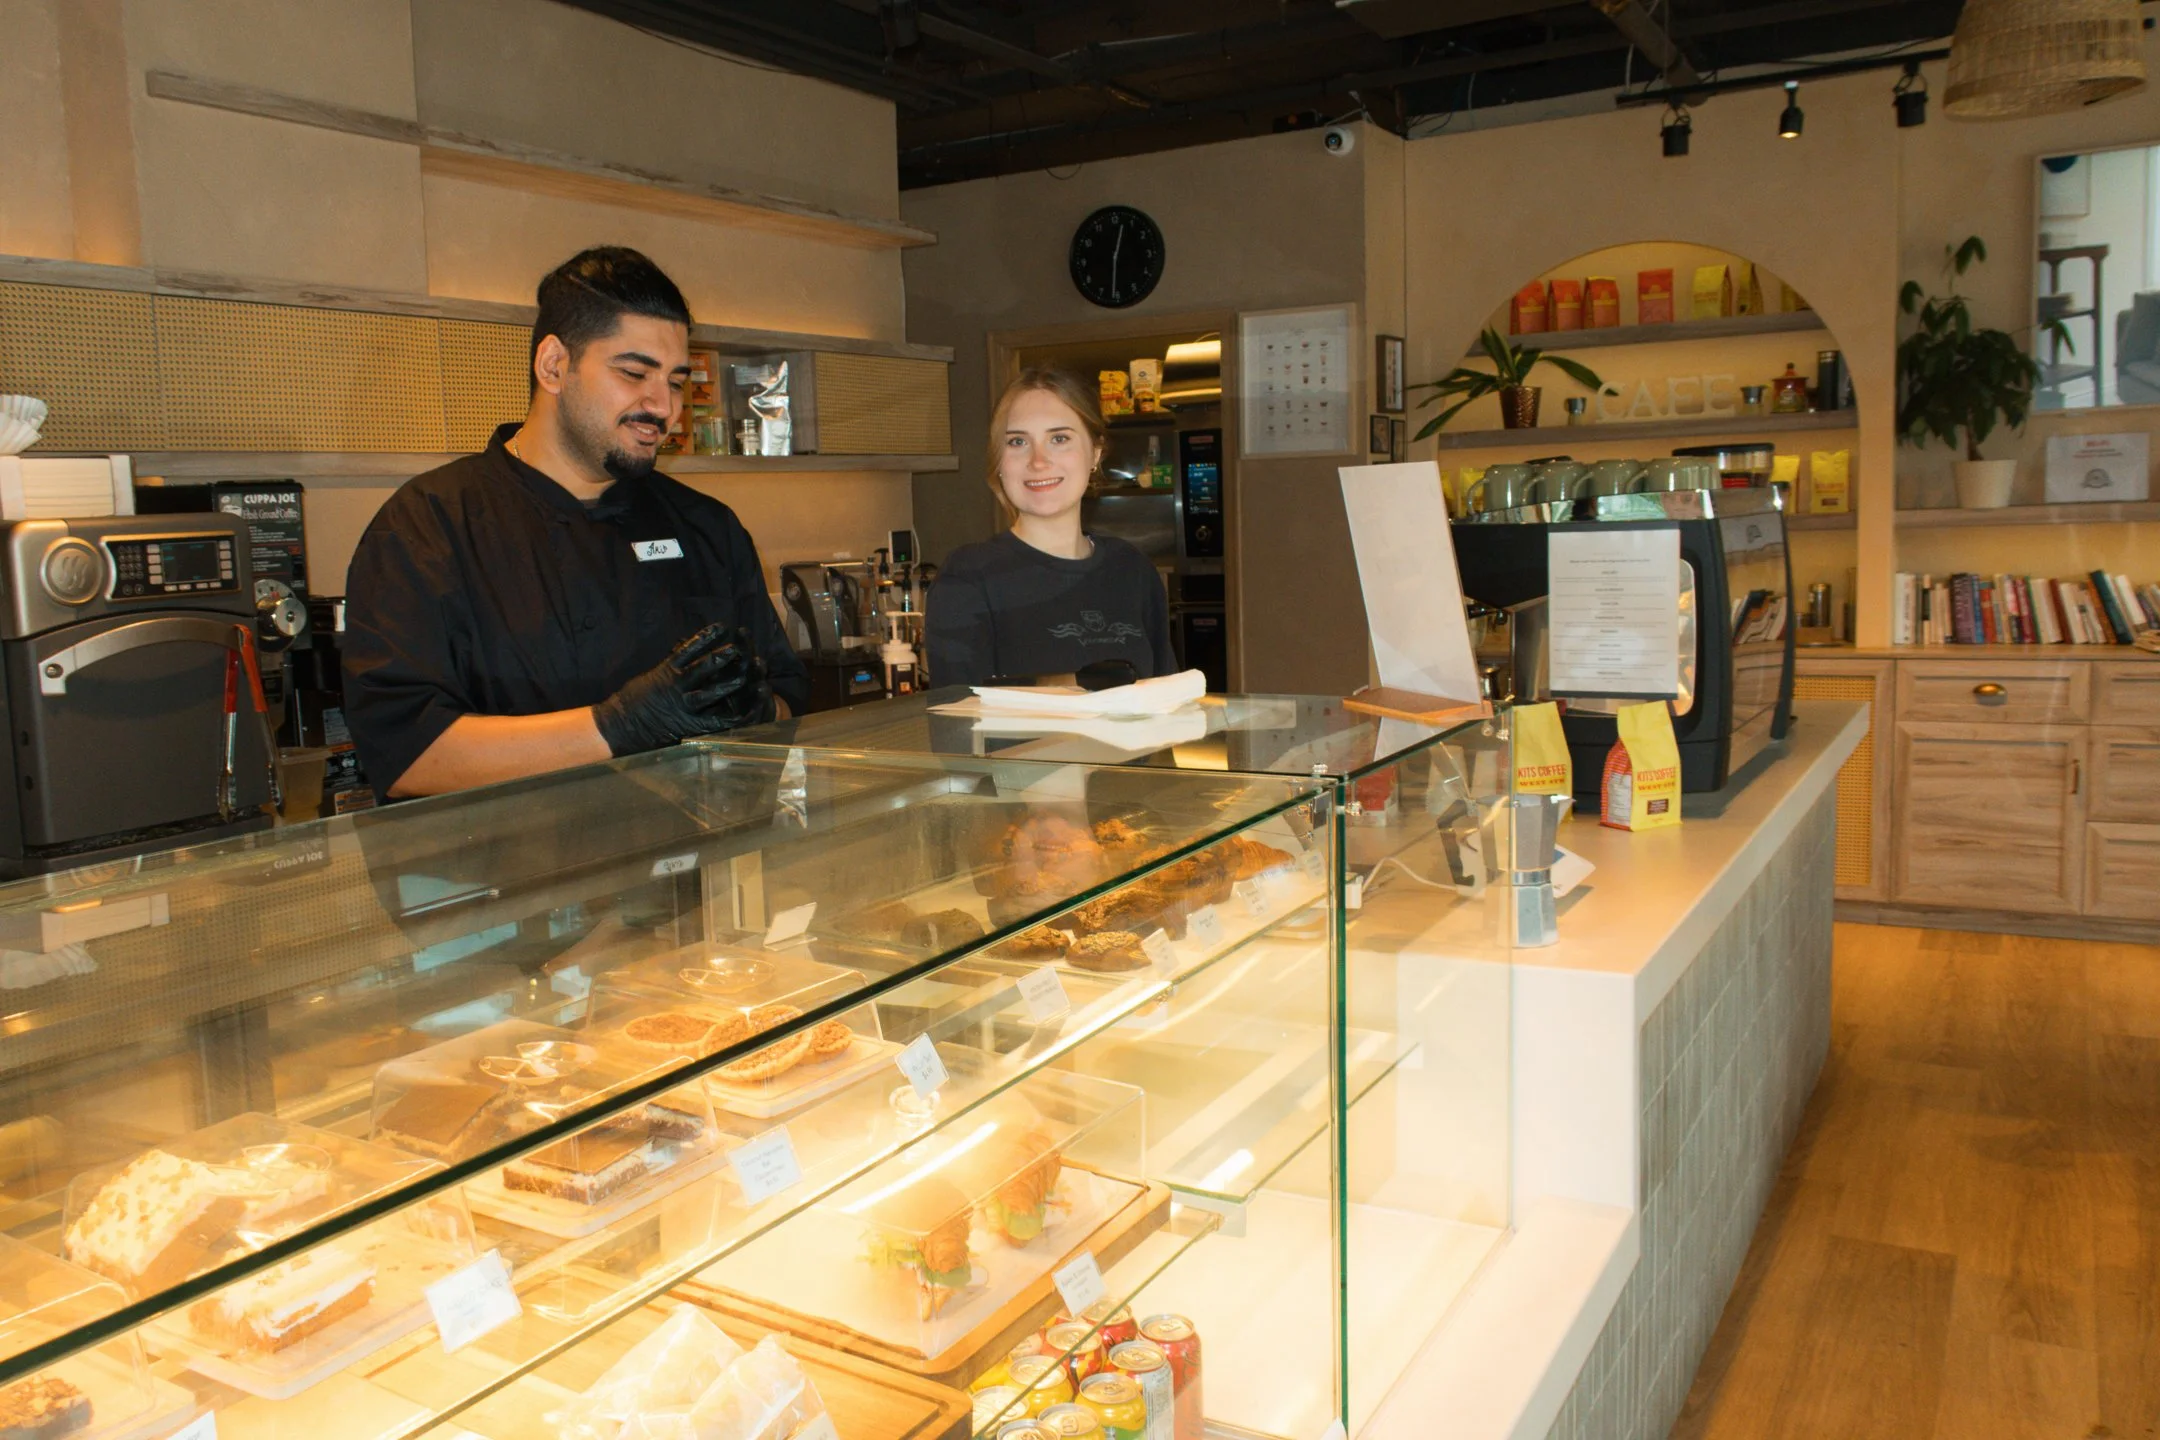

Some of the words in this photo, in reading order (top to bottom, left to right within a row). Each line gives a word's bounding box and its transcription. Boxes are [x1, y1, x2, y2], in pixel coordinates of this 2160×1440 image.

[1140, 230, 1146, 240] 2
[1146, 249, 1152, 258] 3
[1131, 282, 1137, 292] 5
[1597, 374, 1736, 421] CAFE
[244, 494, 278, 504] CUPPA
[278, 493, 296, 503] JOE
[1518, 766, 1537, 778] KITS
[1538, 764, 1567, 777] COFFEE
[1637, 770, 1653, 782] KITS
